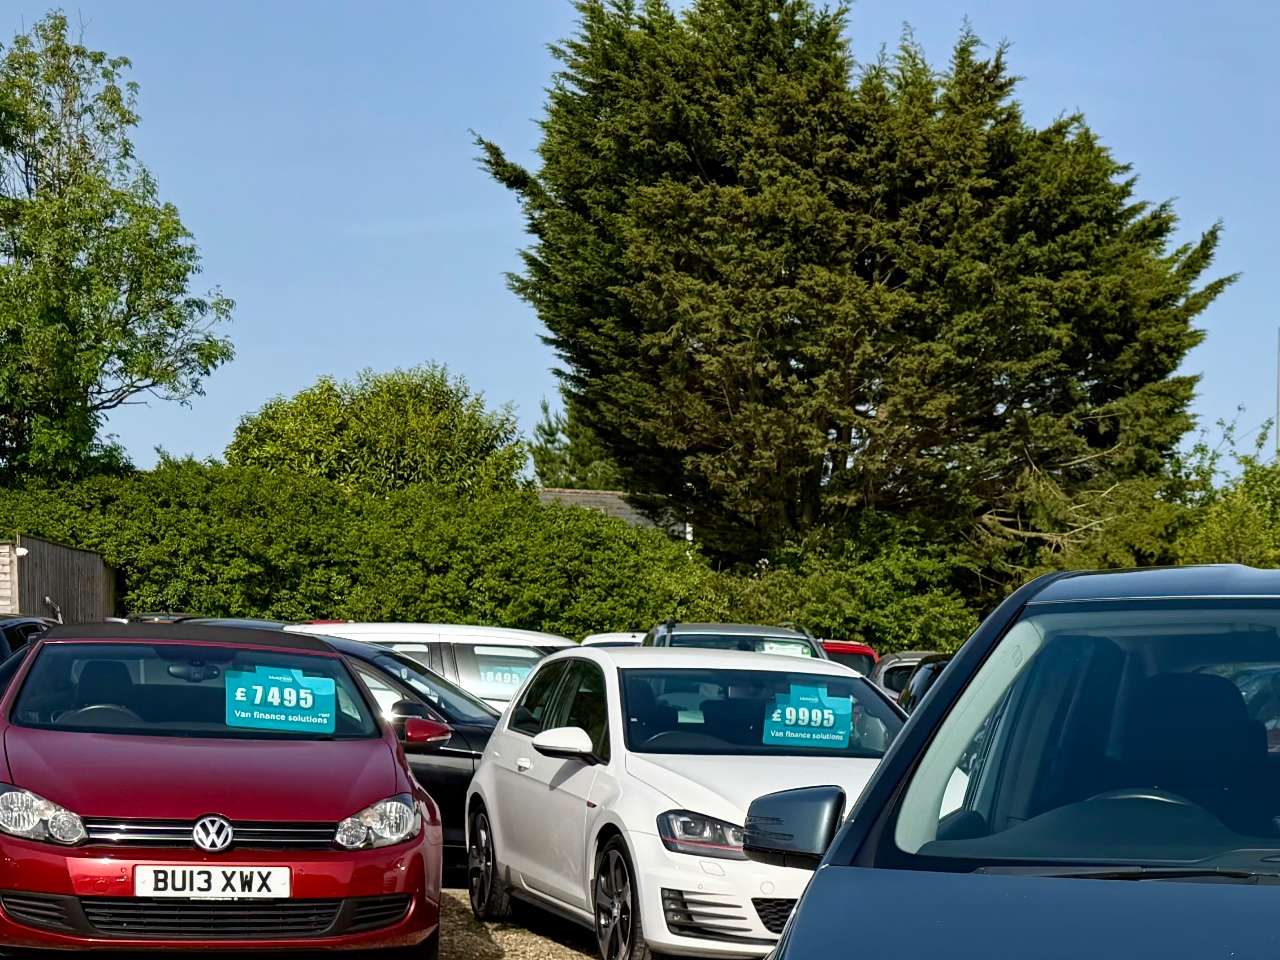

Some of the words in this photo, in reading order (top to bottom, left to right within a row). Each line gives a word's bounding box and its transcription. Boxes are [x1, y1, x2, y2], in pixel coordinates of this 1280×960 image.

[234, 710, 251, 718] Van
[254, 711, 286, 721] finance
[288, 714, 328, 724] solutions
[786, 731, 811, 739] finance
[812, 732, 844, 741] solutions
[153, 869, 212, 892] BU13
[221, 871, 272, 893] XWX
